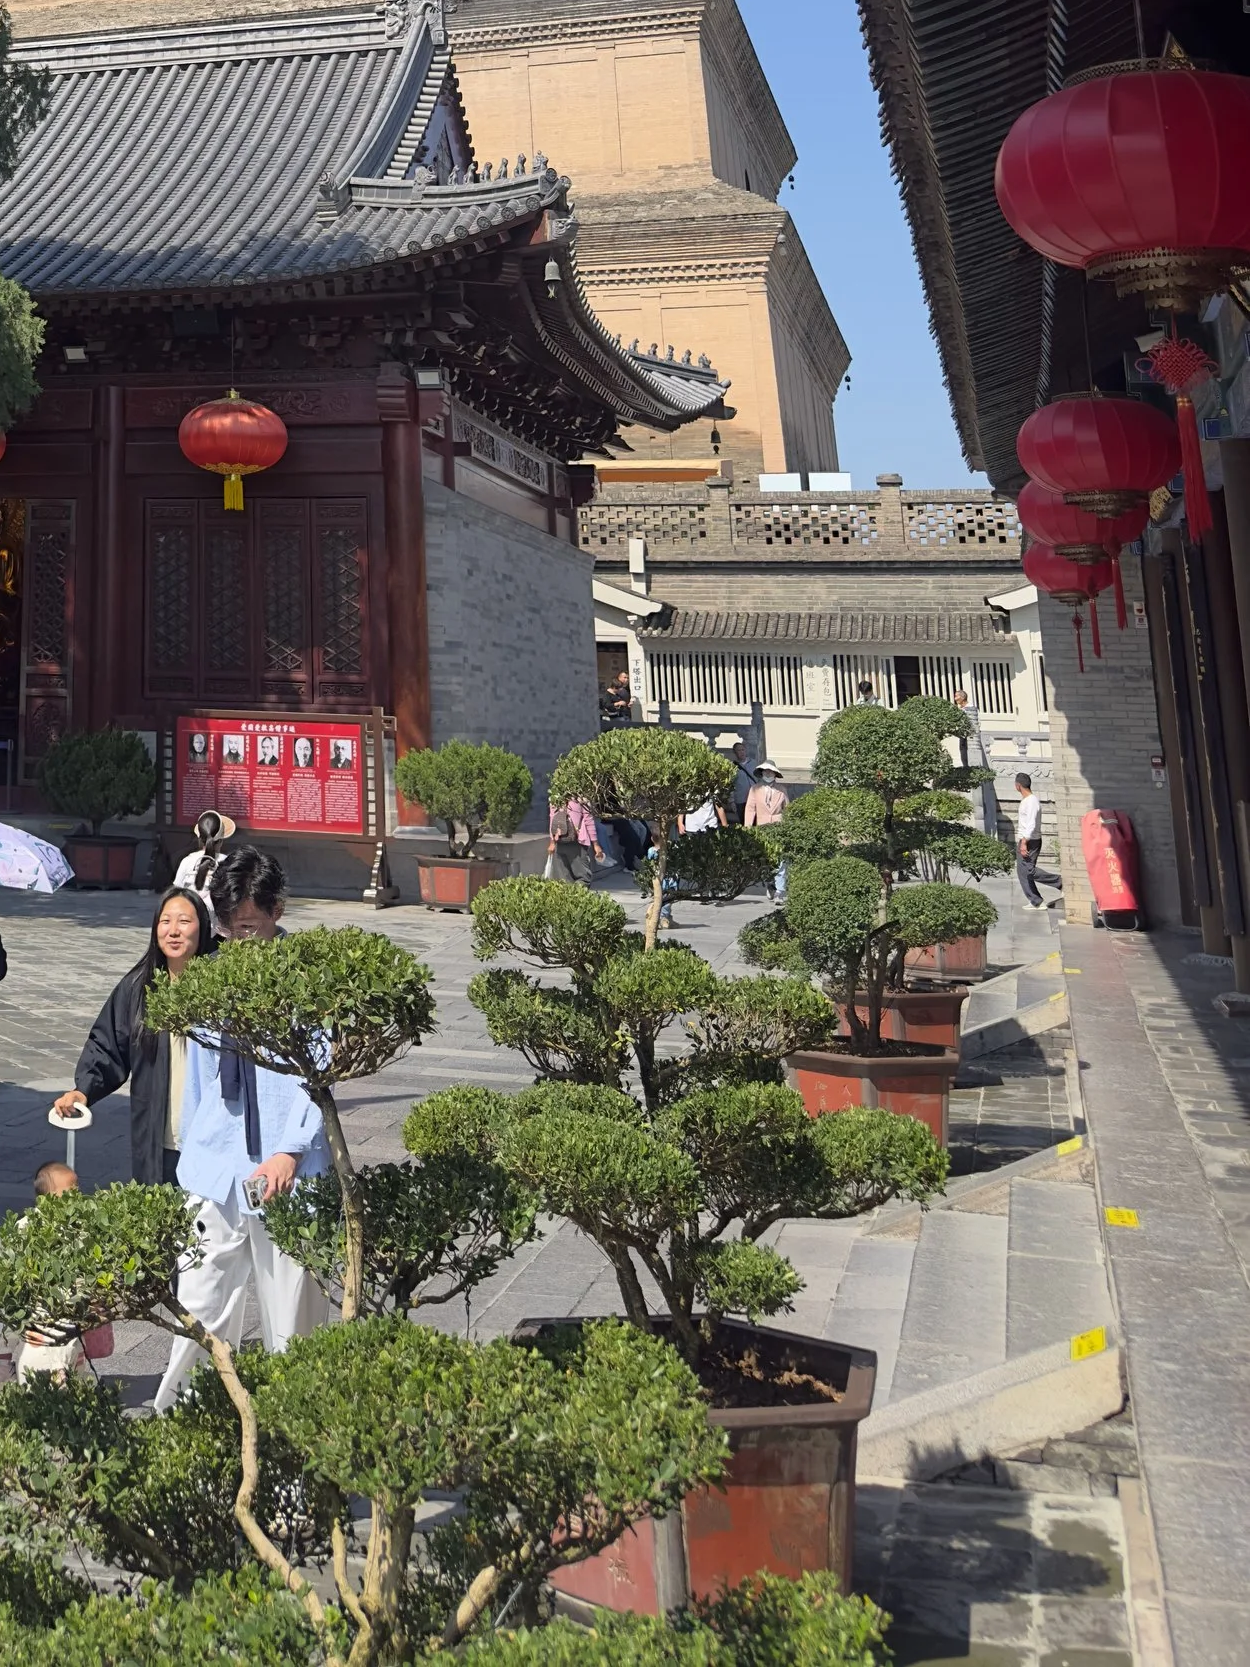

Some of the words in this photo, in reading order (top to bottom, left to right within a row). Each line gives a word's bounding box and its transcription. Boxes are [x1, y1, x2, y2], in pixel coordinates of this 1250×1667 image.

[631, 659, 641, 691] 下塔出口
[1103, 847, 1122, 886] 灭火器
